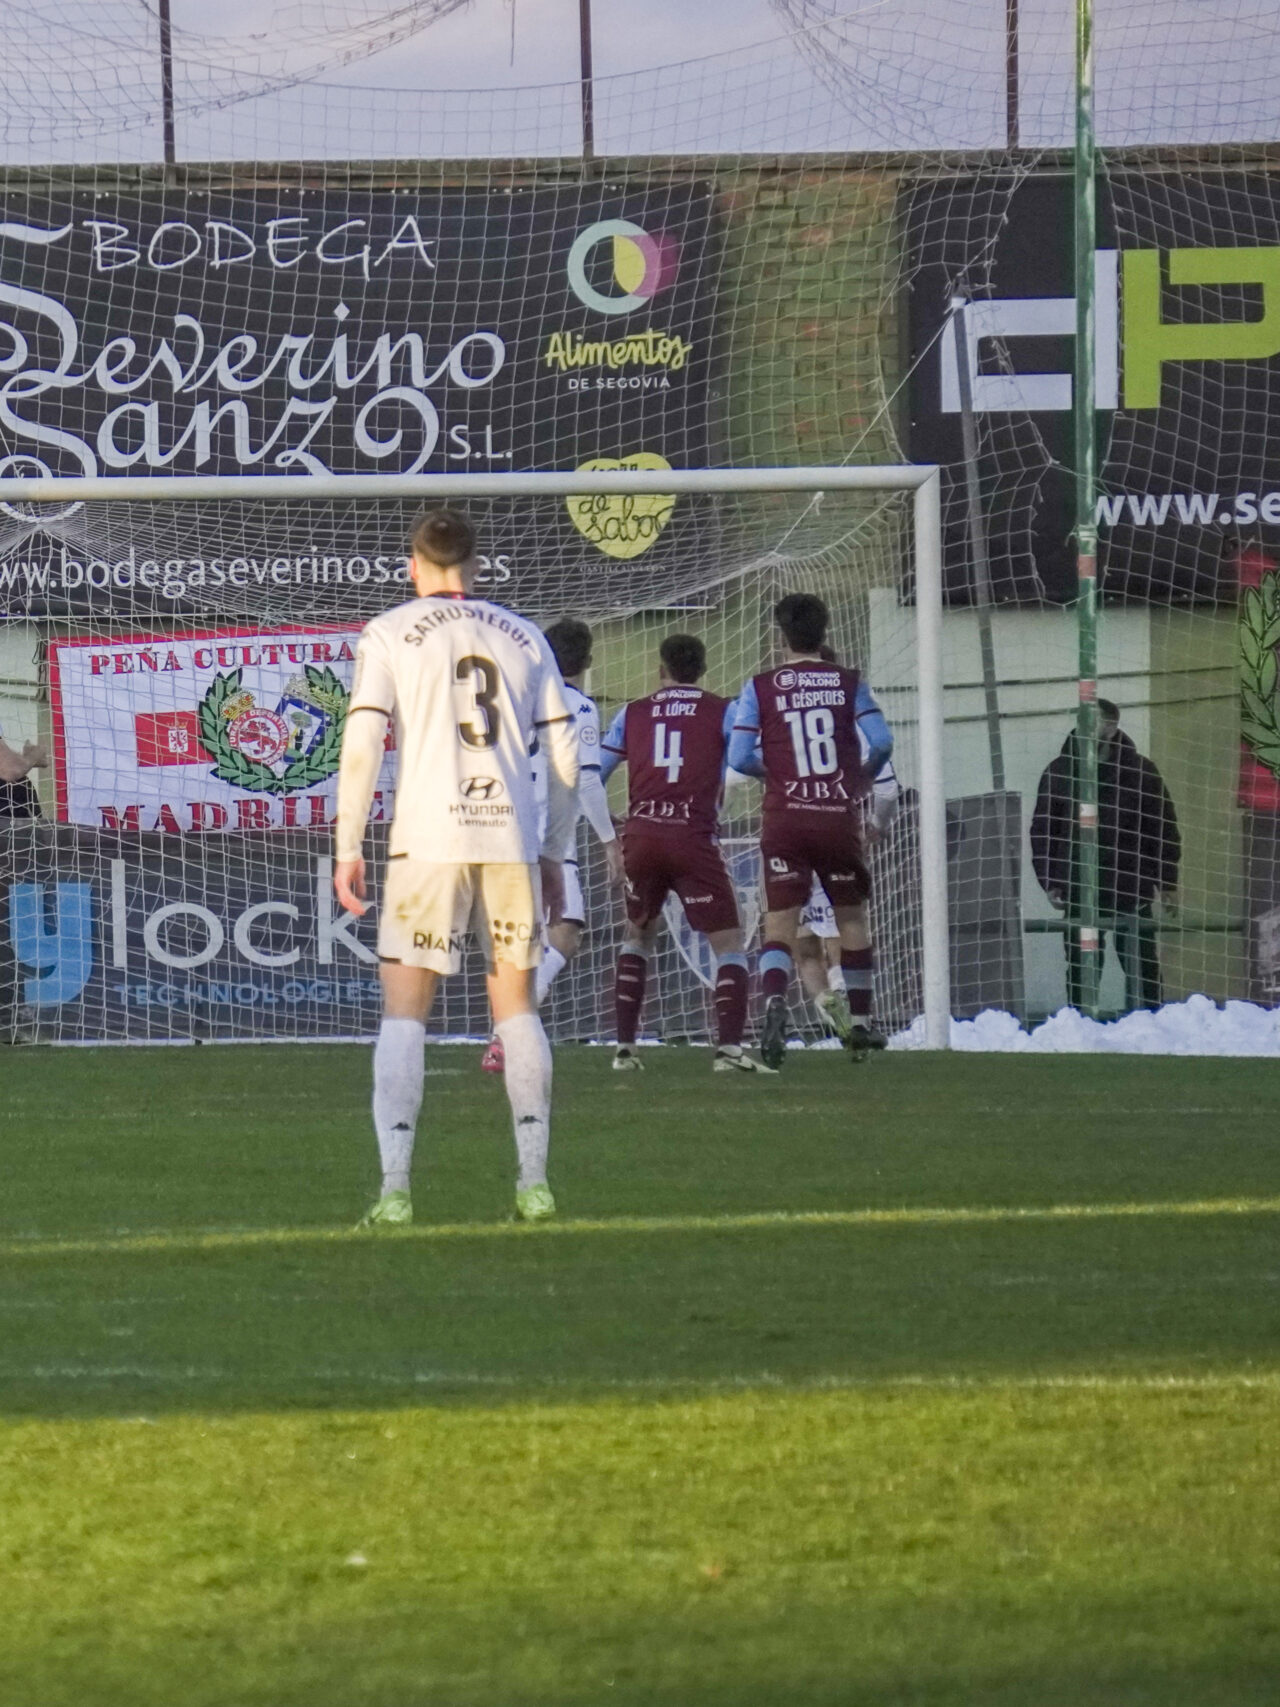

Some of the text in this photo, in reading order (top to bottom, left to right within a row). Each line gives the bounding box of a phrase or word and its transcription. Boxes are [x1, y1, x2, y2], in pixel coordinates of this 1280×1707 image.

[82, 214, 436, 282] BODEGA
[544, 328, 693, 370] Alimentos
[568, 376, 671, 390] DE SEGOVIA
[449, 424, 513, 460] S.L.
[404, 605, 531, 648] SATRUSTEGUI
[88, 640, 355, 676] PEÑA CULTURA
[792, 689, 846, 710] CÉSPEDES
[798, 677, 841, 688] PALOMO
[451, 654, 500, 752] 3
[666, 702, 697, 717] LÓPEZ
[654, 722, 684, 783] 4
[784, 707, 839, 778] 18
[449, 803, 514, 816] HYUNDAI
[458, 817, 508, 828] Lemauto
